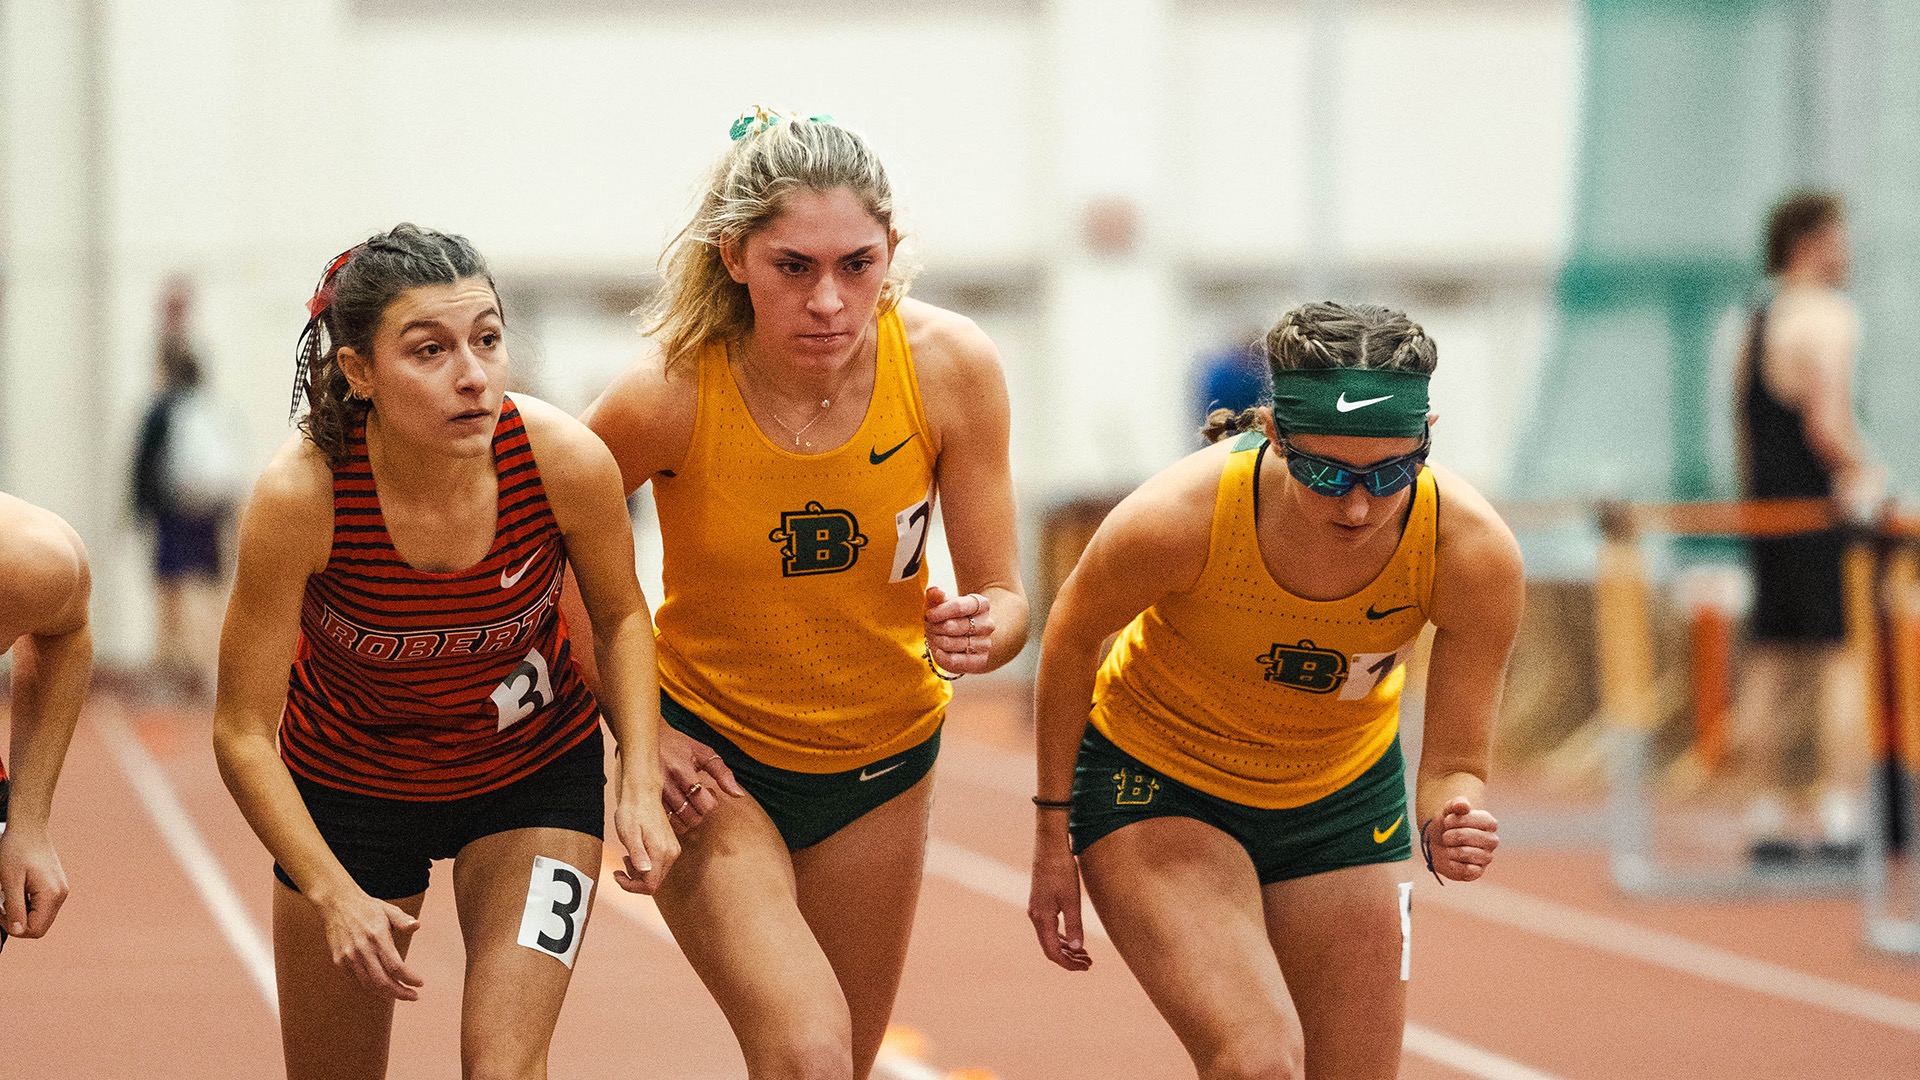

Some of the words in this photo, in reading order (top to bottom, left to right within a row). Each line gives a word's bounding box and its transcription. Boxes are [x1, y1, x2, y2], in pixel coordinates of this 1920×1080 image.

[776, 505, 865, 578] B
[503, 660, 545, 712] 3
[1260, 640, 1349, 694] B
[536, 868, 582, 954] 3
